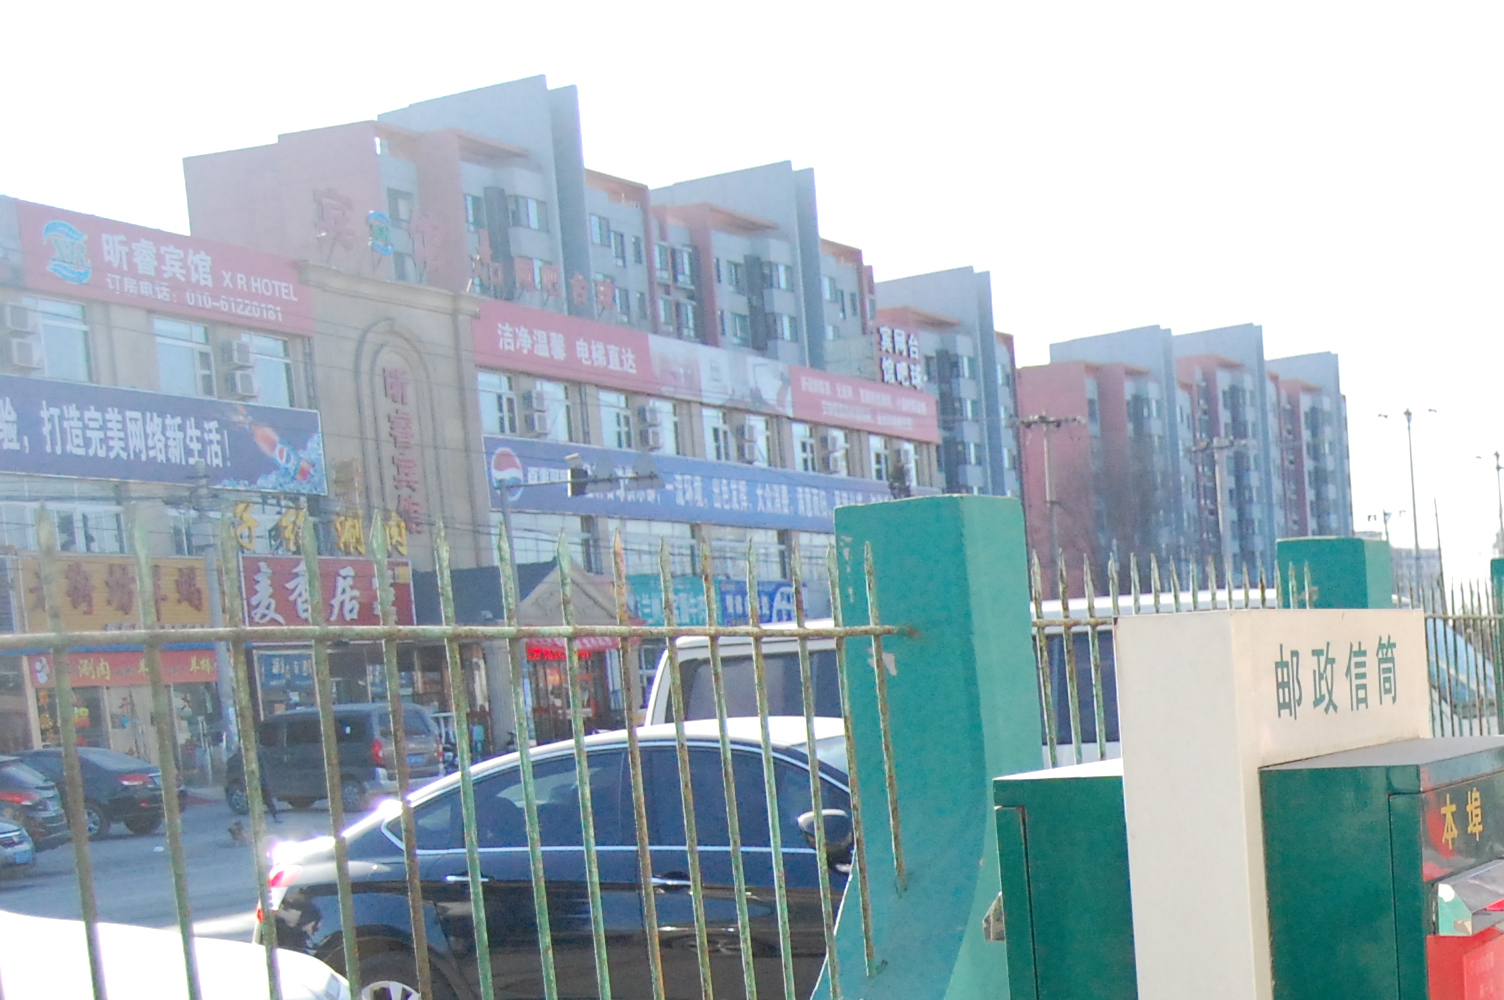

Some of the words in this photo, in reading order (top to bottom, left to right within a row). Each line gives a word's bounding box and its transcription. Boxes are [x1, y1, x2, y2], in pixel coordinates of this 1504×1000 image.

[102, 233, 212, 287] 昕睿宾馆
[251, 277, 298, 301] HOTEL
[1274, 634, 1397, 720] 邮政信筒
[1440, 787, 1483, 850] 本埠
